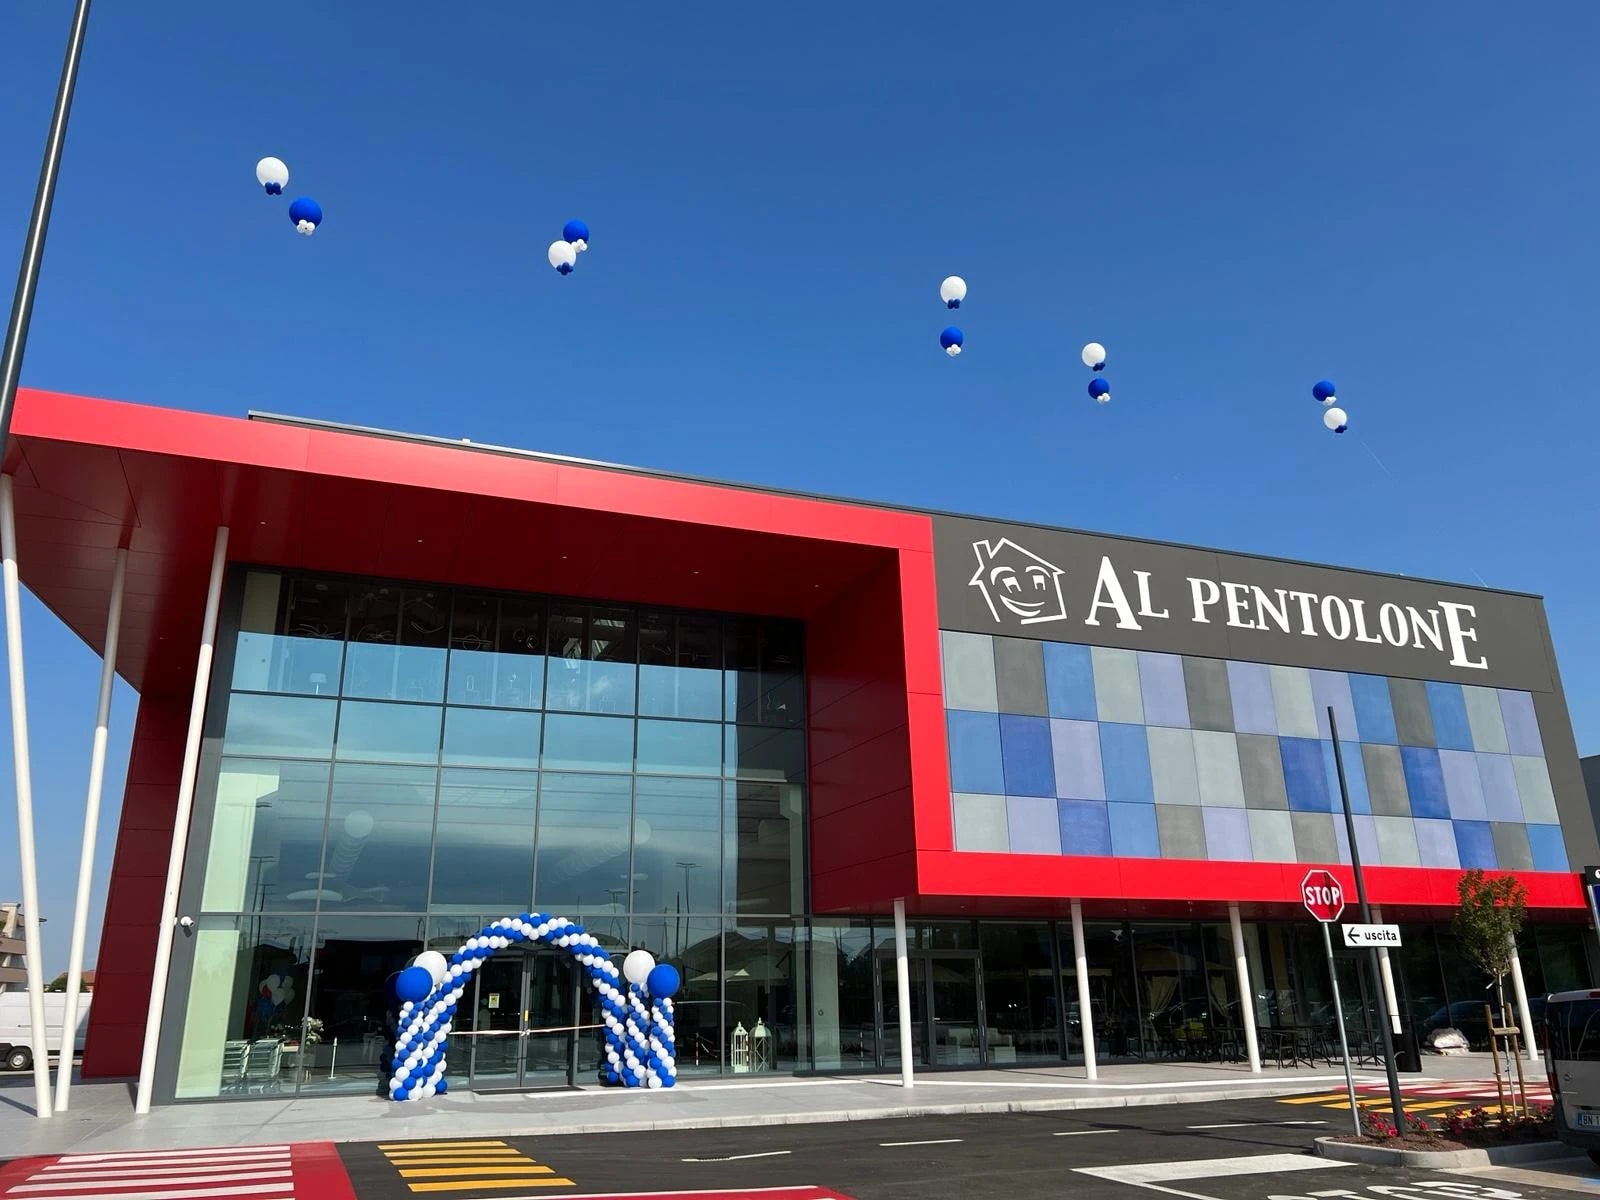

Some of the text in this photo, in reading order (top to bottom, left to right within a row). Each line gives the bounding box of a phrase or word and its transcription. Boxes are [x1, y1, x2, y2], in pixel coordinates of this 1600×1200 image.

[1084, 555, 1489, 670] AL PENTOLONE
[1305, 886, 1340, 906] STOP
[1364, 929, 1398, 941] uscita
